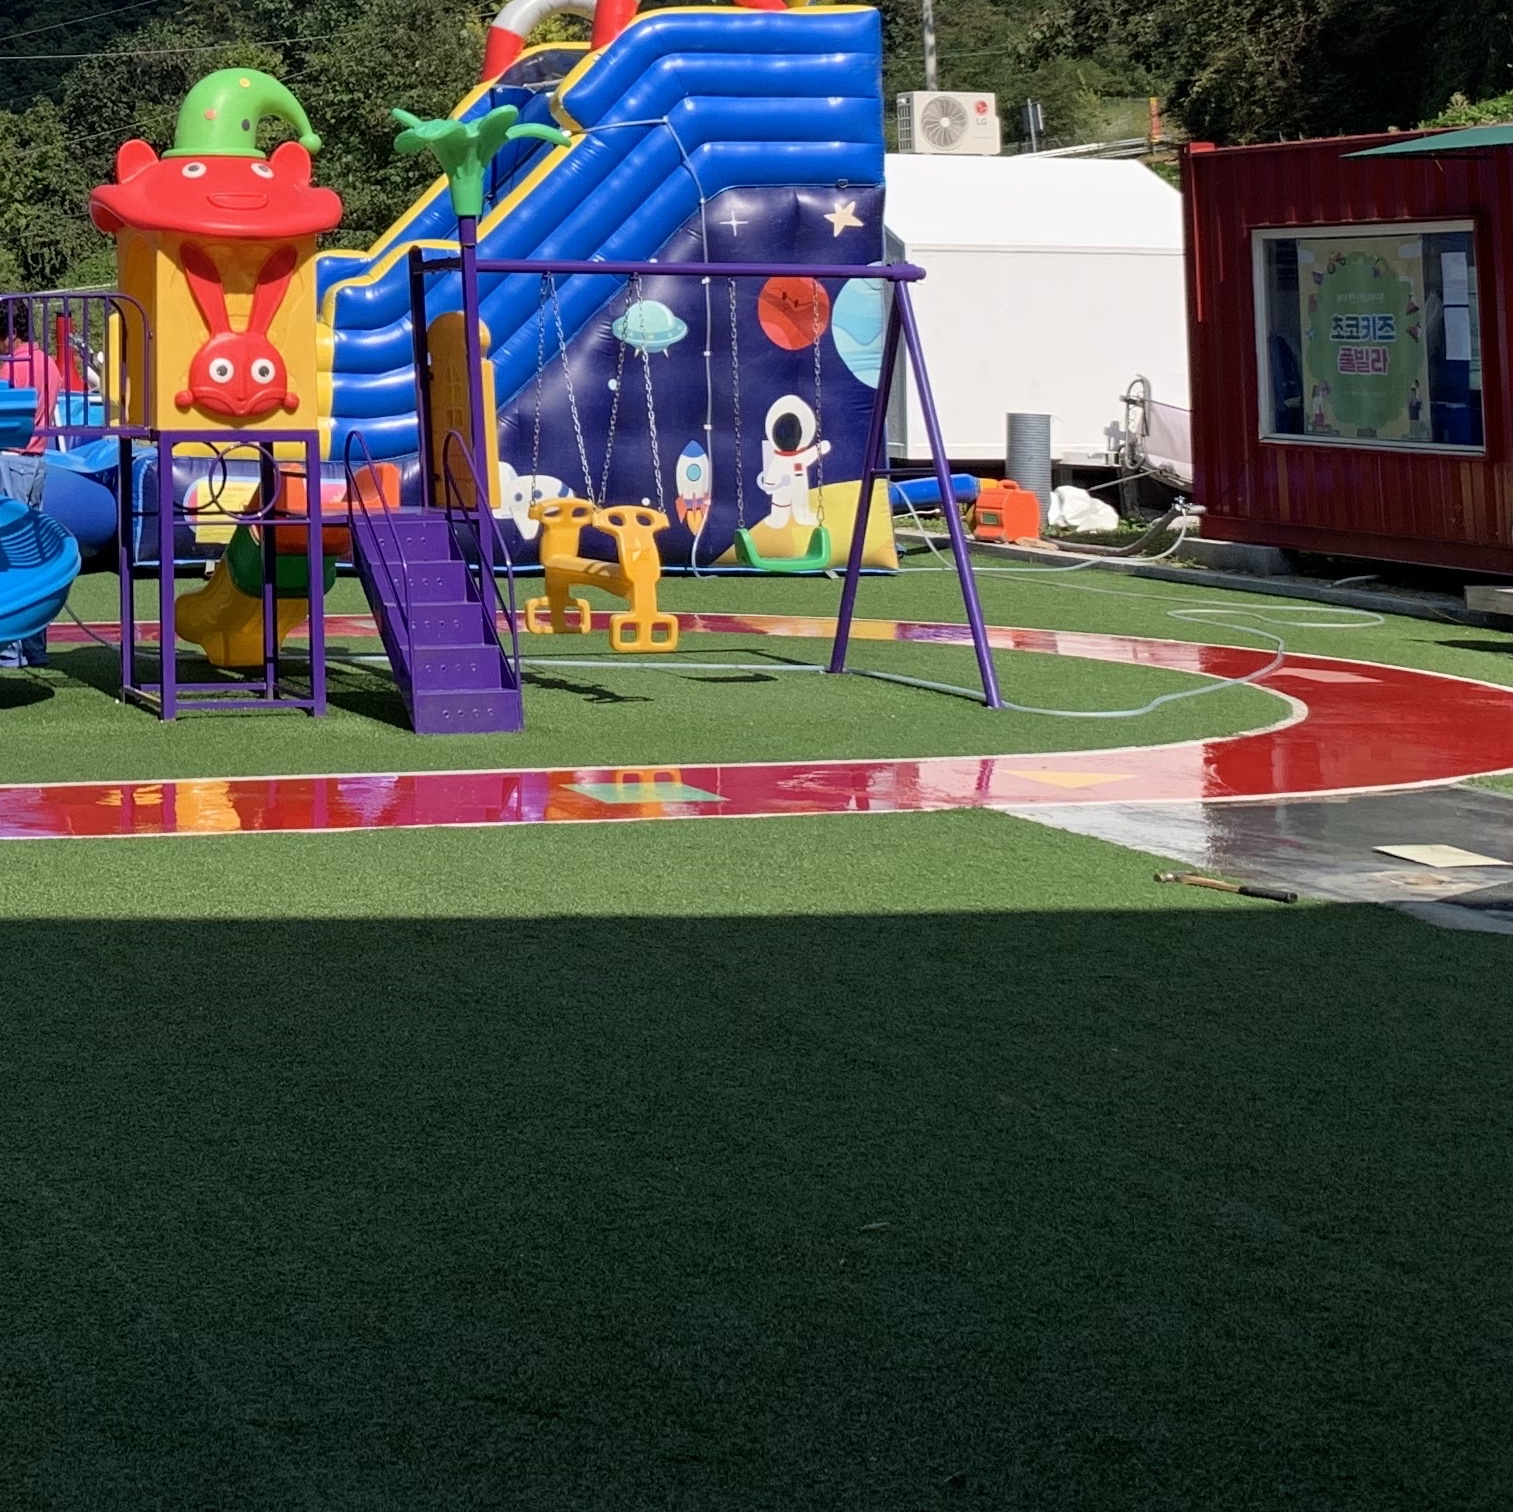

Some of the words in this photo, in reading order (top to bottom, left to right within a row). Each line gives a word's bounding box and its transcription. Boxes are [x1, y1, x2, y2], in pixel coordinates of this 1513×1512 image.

[976, 117, 988, 126] LG
[1330, 314, 1396, 342] 초코키즈
[1338, 346, 1389, 375] 풀빌라
